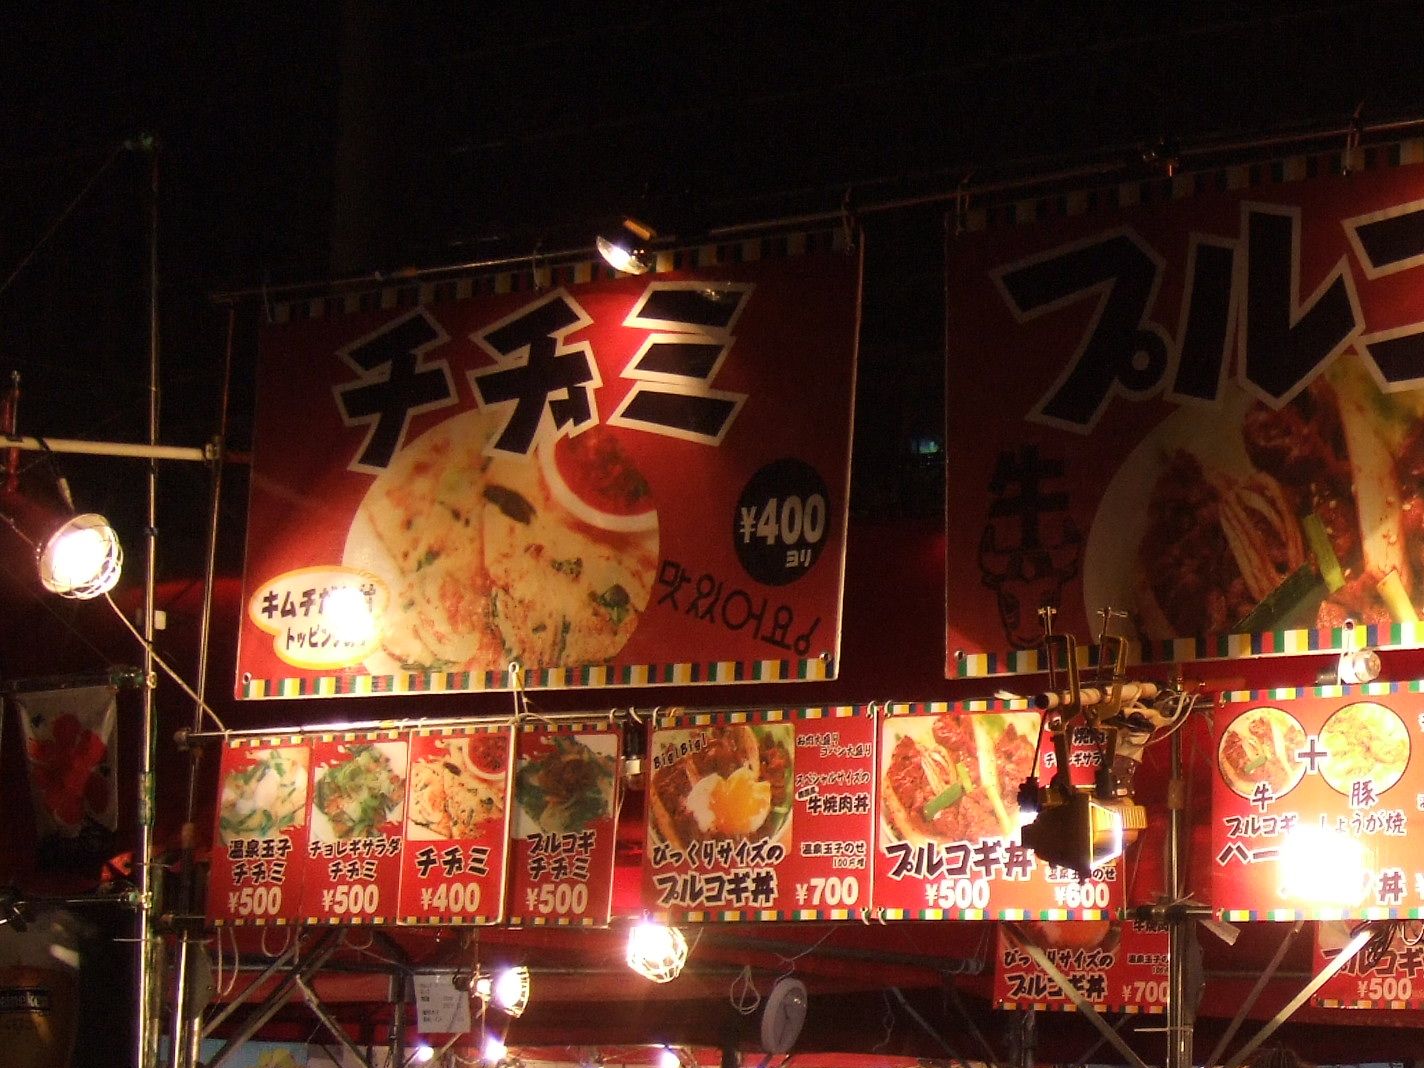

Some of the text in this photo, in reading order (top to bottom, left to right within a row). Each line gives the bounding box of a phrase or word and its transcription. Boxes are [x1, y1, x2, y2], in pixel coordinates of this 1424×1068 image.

[739, 493, 824, 548] ¥400
[808, 793, 869, 815] 牛焼肉丼
[1252, 784, 1273, 810] 牛
[1352, 780, 1376, 806] 豚
[228, 839, 292, 859] 温泉玉子
[309, 837, 401, 859] チョレギサラダ
[527, 831, 596, 857] プルコギ
[653, 840, 784, 866] びっくりサイズの
[886, 840, 1033, 878] プルコギ丼
[228, 886, 282, 915] ¥500
[322, 884, 380, 914] ¥500
[421, 883, 481, 912] ¥400
[526, 883, 588, 914] ¥500
[656, 873, 775, 904] プルコギ丼
[796, 877, 858, 905] ¥700
[925, 880, 990, 908] ¥500
[1055, 882, 1110, 908] ¥600
[1358, 978, 1412, 1000] ¥500
